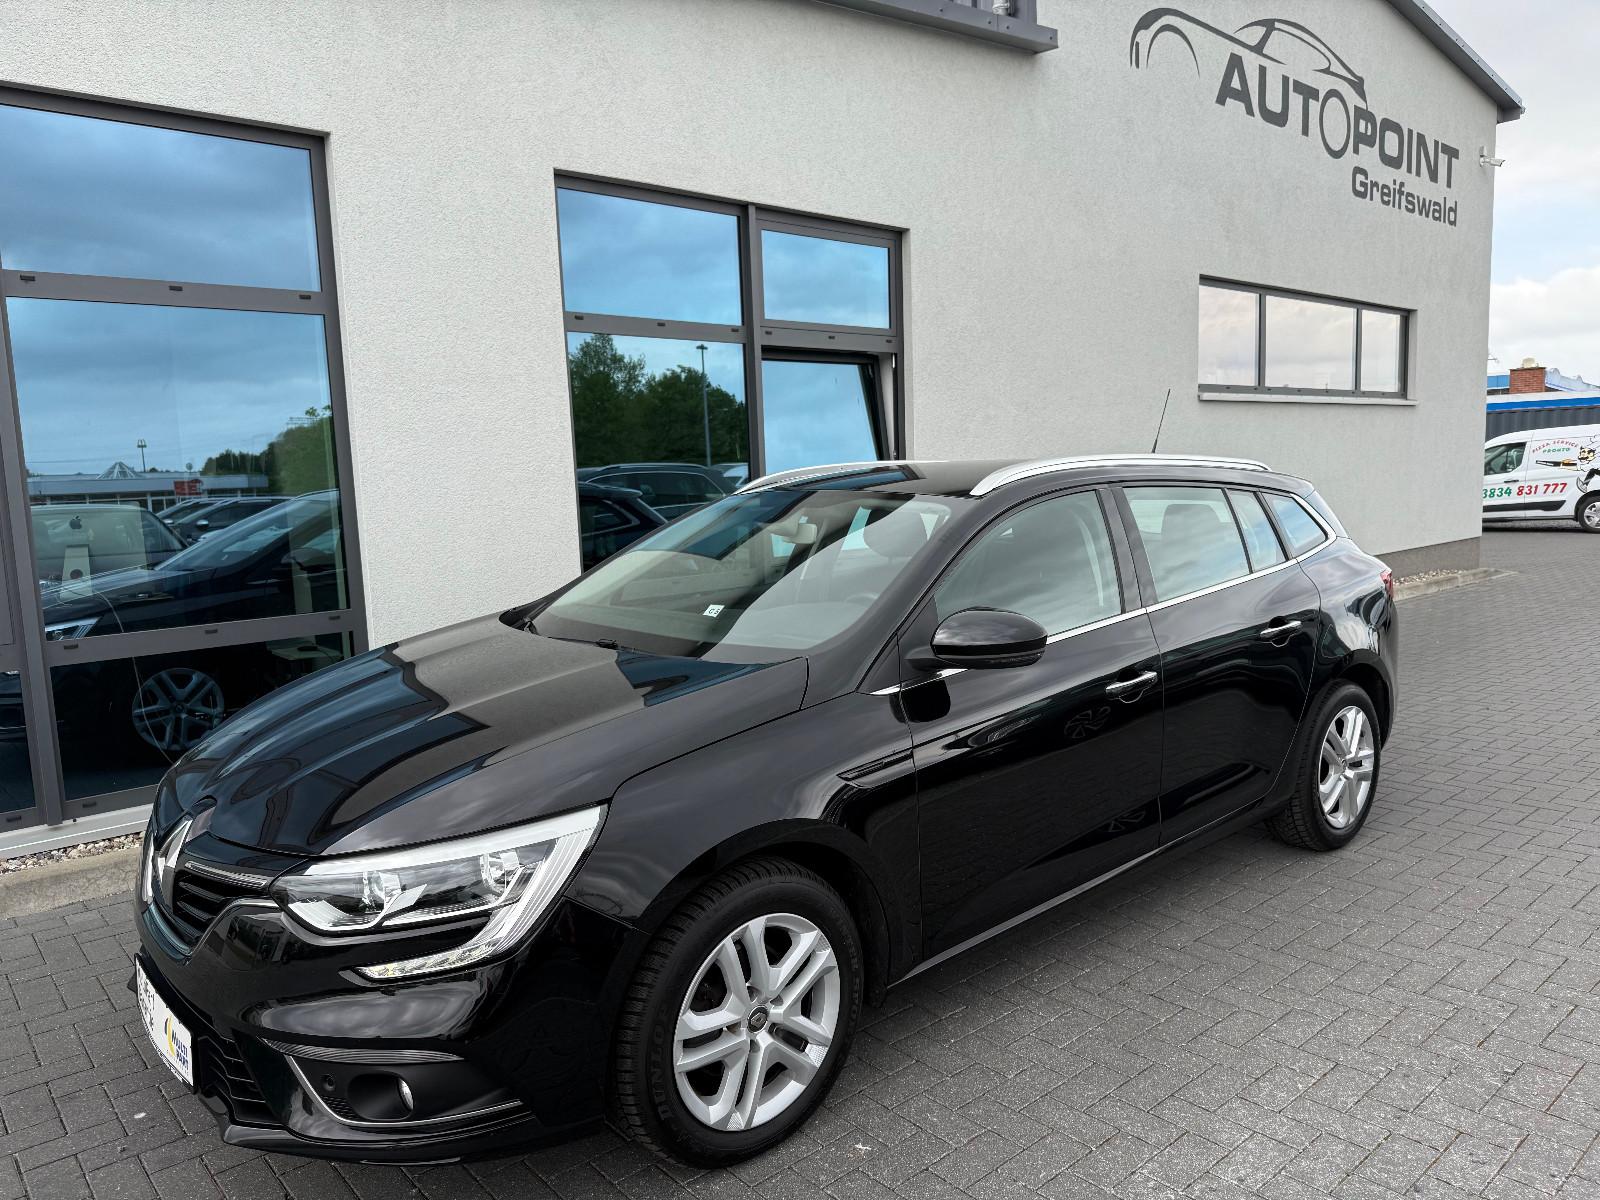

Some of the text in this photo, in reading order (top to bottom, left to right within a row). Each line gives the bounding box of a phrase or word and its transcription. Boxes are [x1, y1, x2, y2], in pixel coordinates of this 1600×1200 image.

[1215, 52, 1460, 189] AUTOPOINT
[1351, 165, 1458, 227] Greifswald
[1516, 485, 1538, 496] 831
[1543, 482, 1567, 495] 777
